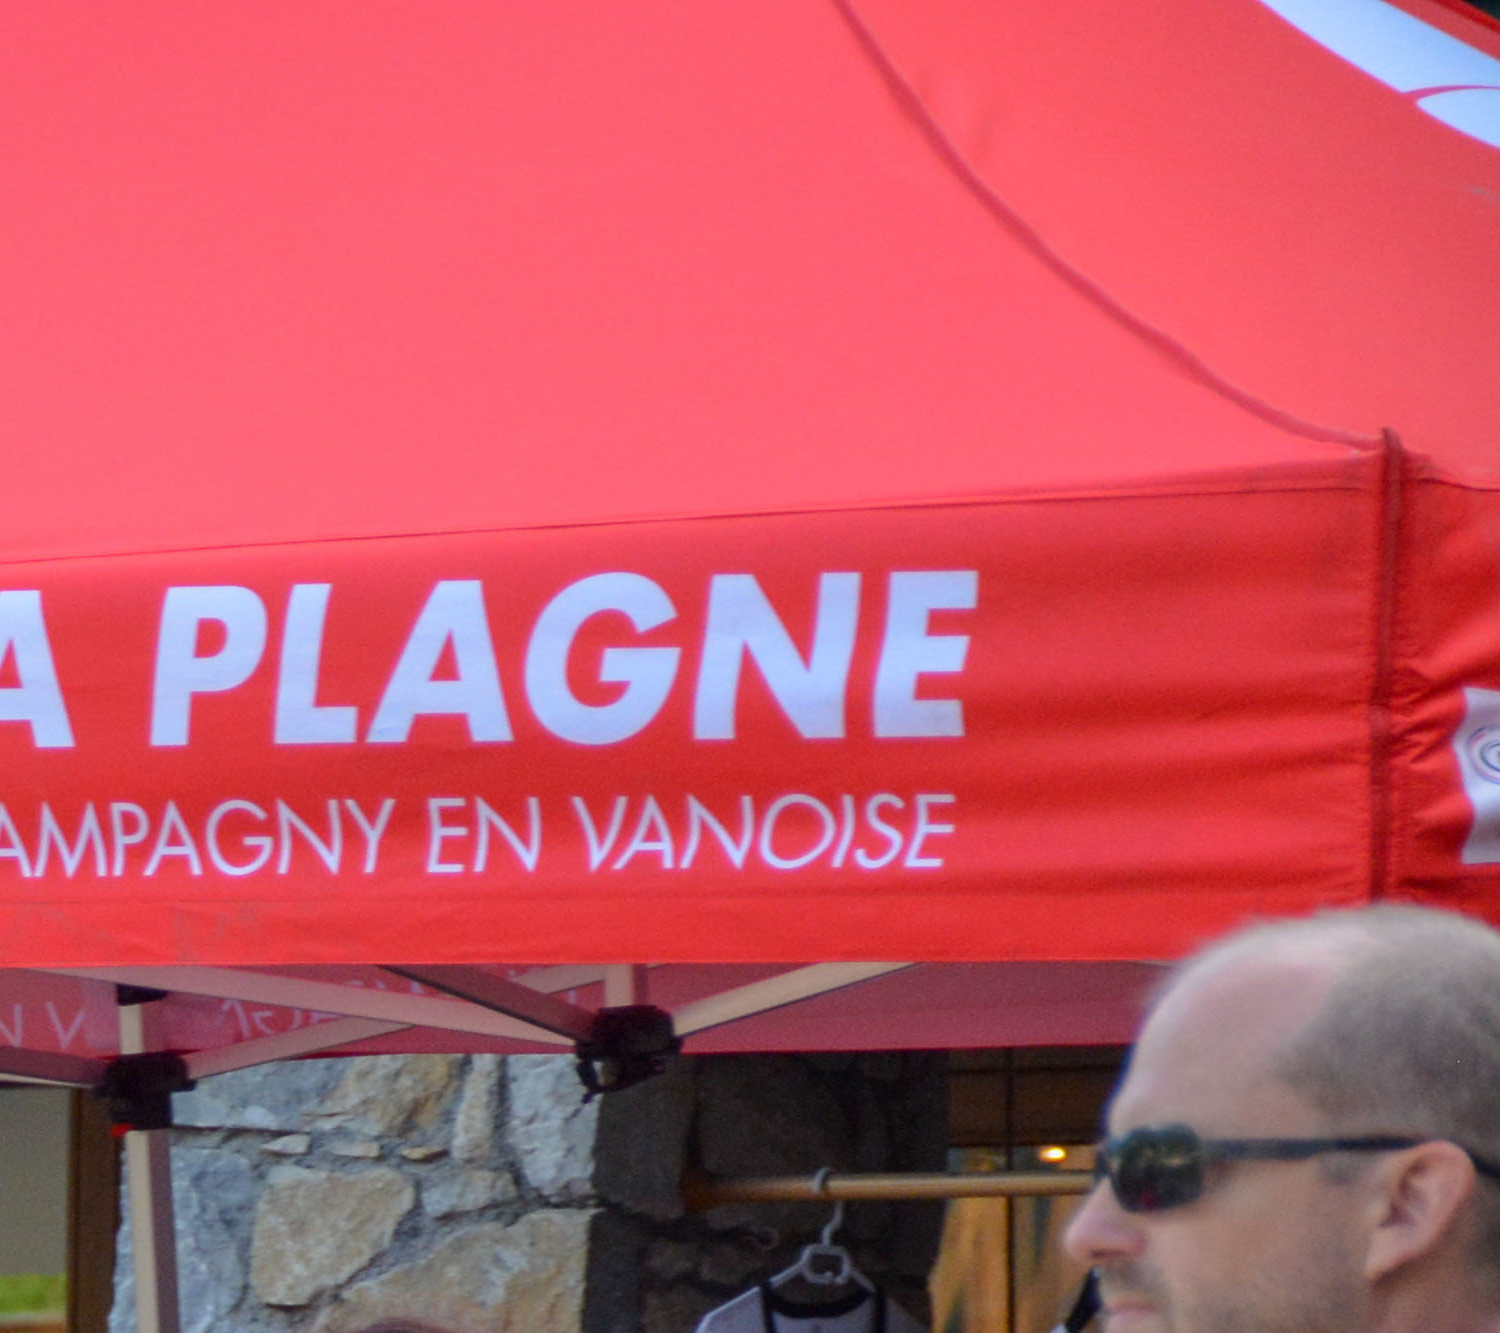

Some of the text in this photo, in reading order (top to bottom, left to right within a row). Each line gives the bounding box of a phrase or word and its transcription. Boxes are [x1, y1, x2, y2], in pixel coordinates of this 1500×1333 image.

[149, 570, 980, 748] PLAGNE
[426, 796, 542, 873] EN
[570, 792, 956, 872] VANOISE
